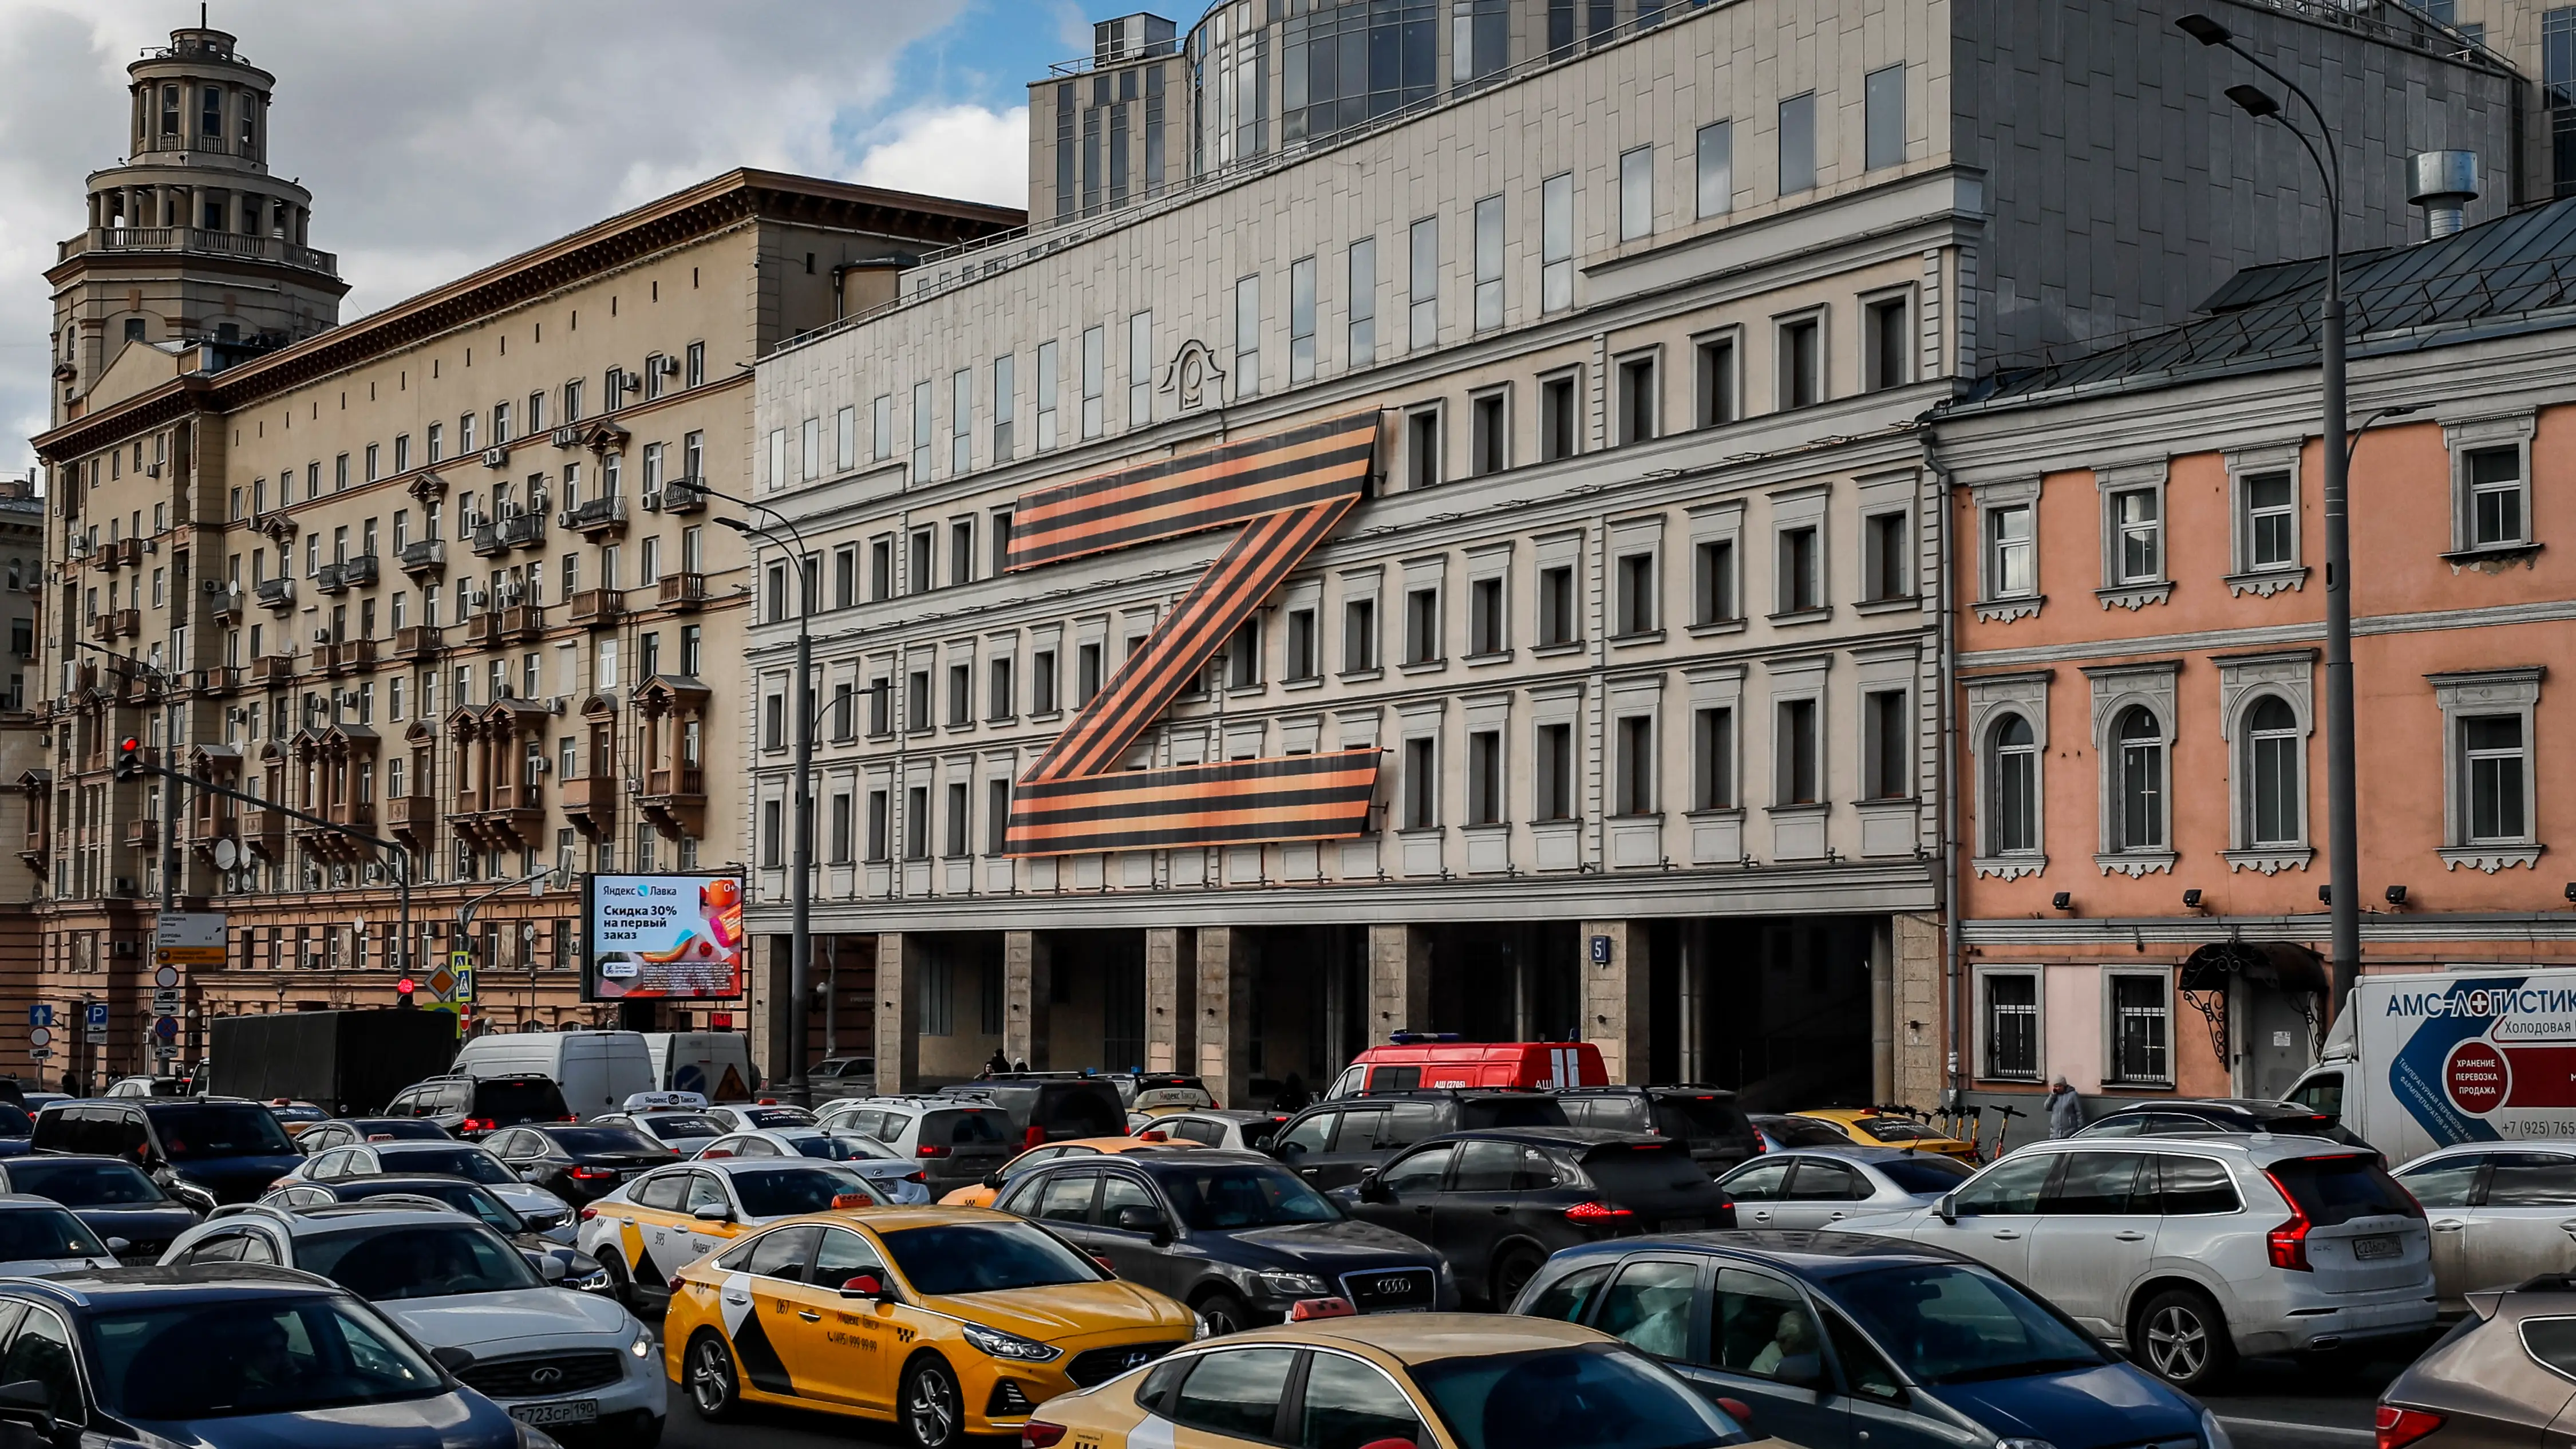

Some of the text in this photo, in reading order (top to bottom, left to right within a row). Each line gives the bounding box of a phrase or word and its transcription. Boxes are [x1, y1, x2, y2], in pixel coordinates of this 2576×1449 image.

[1002, 404, 1382, 858] Z
[603, 886, 677, 896] Яндекс Лавка
[724, 883, 735, 892] 0+
[604, 906, 677, 917] Скидка 30%
[604, 917, 667, 929] на первый
[604, 931, 637, 939] заказ
[1595, 941, 1602, 958] 5
[2456, 1059, 2495, 1068] ХРАНЕНИЕ
[2456, 1073, 2498, 1081] ПЕРЕВОЗКА
[1536, 1080, 1552, 1089] АШ
[2459, 1086, 2496, 1096] ПРОДАЖА
[2399, 1057, 2439, 1104] ТЕМПЕРАТУРНАЯ
[2437, 1101, 2466, 1135] ПЕРЕВОЗКА
[2400, 1076, 2444, 1127] ФАРМПРЕПАРАТОВ
[2503, 1122, 2516, 1134] +7
[2520, 1120, 2550, 1138] (925)
[776, 1299, 790, 1314] 067
[836, 1308, 860, 1326] Яндекс
[833, 1332, 878, 1353] (495) 999 99 99
[517, 1403, 594, 1423] Т723СР 190
